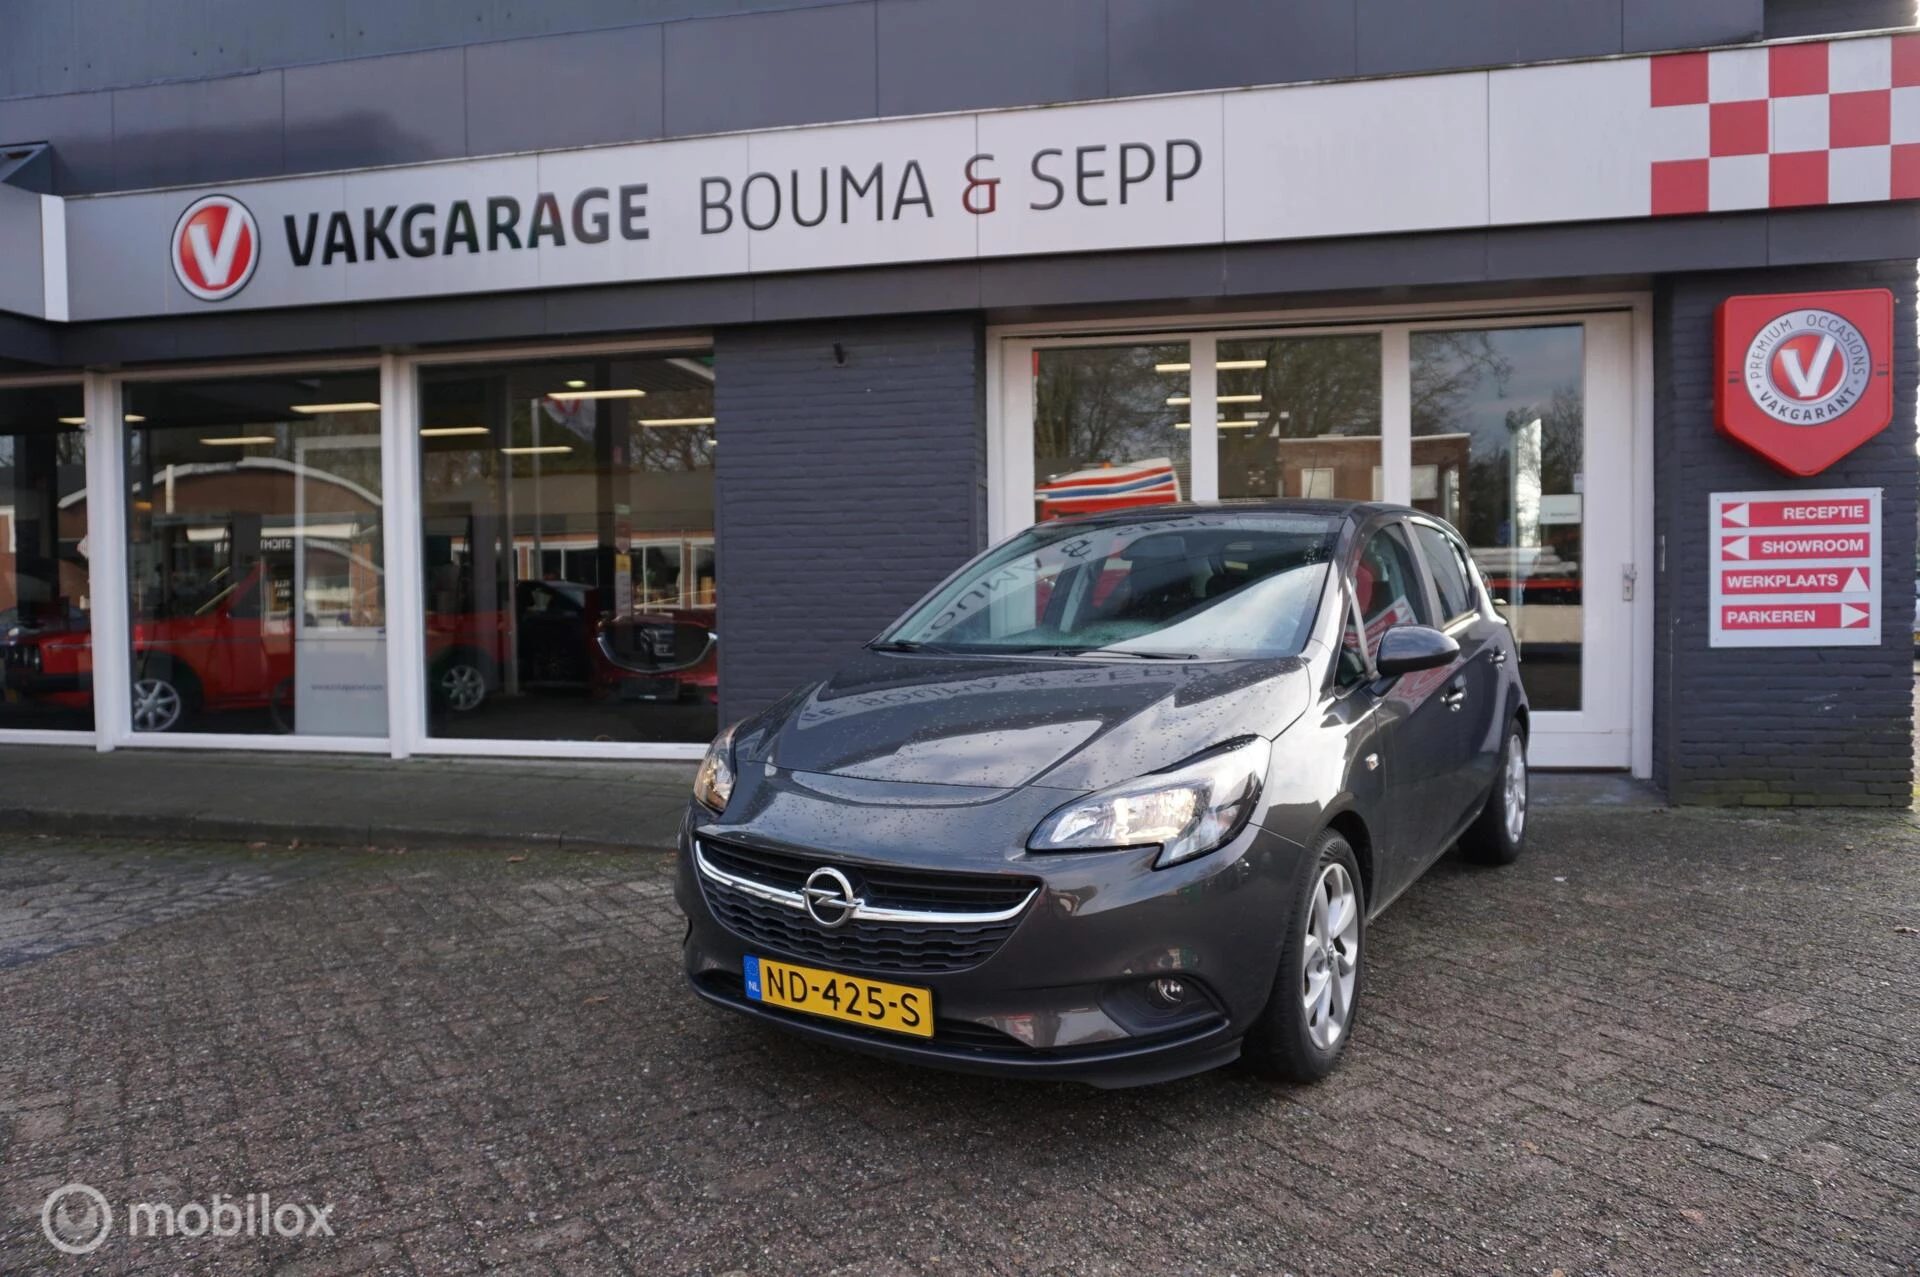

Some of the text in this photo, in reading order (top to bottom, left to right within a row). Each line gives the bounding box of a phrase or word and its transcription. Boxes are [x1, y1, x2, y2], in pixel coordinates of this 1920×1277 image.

[284, 138, 1202, 266] VAKGARAGE BOUMA & SEPP
[1750, 313, 1866, 379] PREMIUM OCCASIONS
[1759, 386, 1857, 421] VAKGARANT
[1783, 505, 1864, 520] RECEPTIE
[1761, 539, 1864, 554] SHOWROOM
[1727, 574, 1839, 588] WERKPLAATS
[1727, 610, 1816, 623] PARKEREN
[748, 980, 760, 992] NL
[766, 965, 921, 1027] ND-425-S
